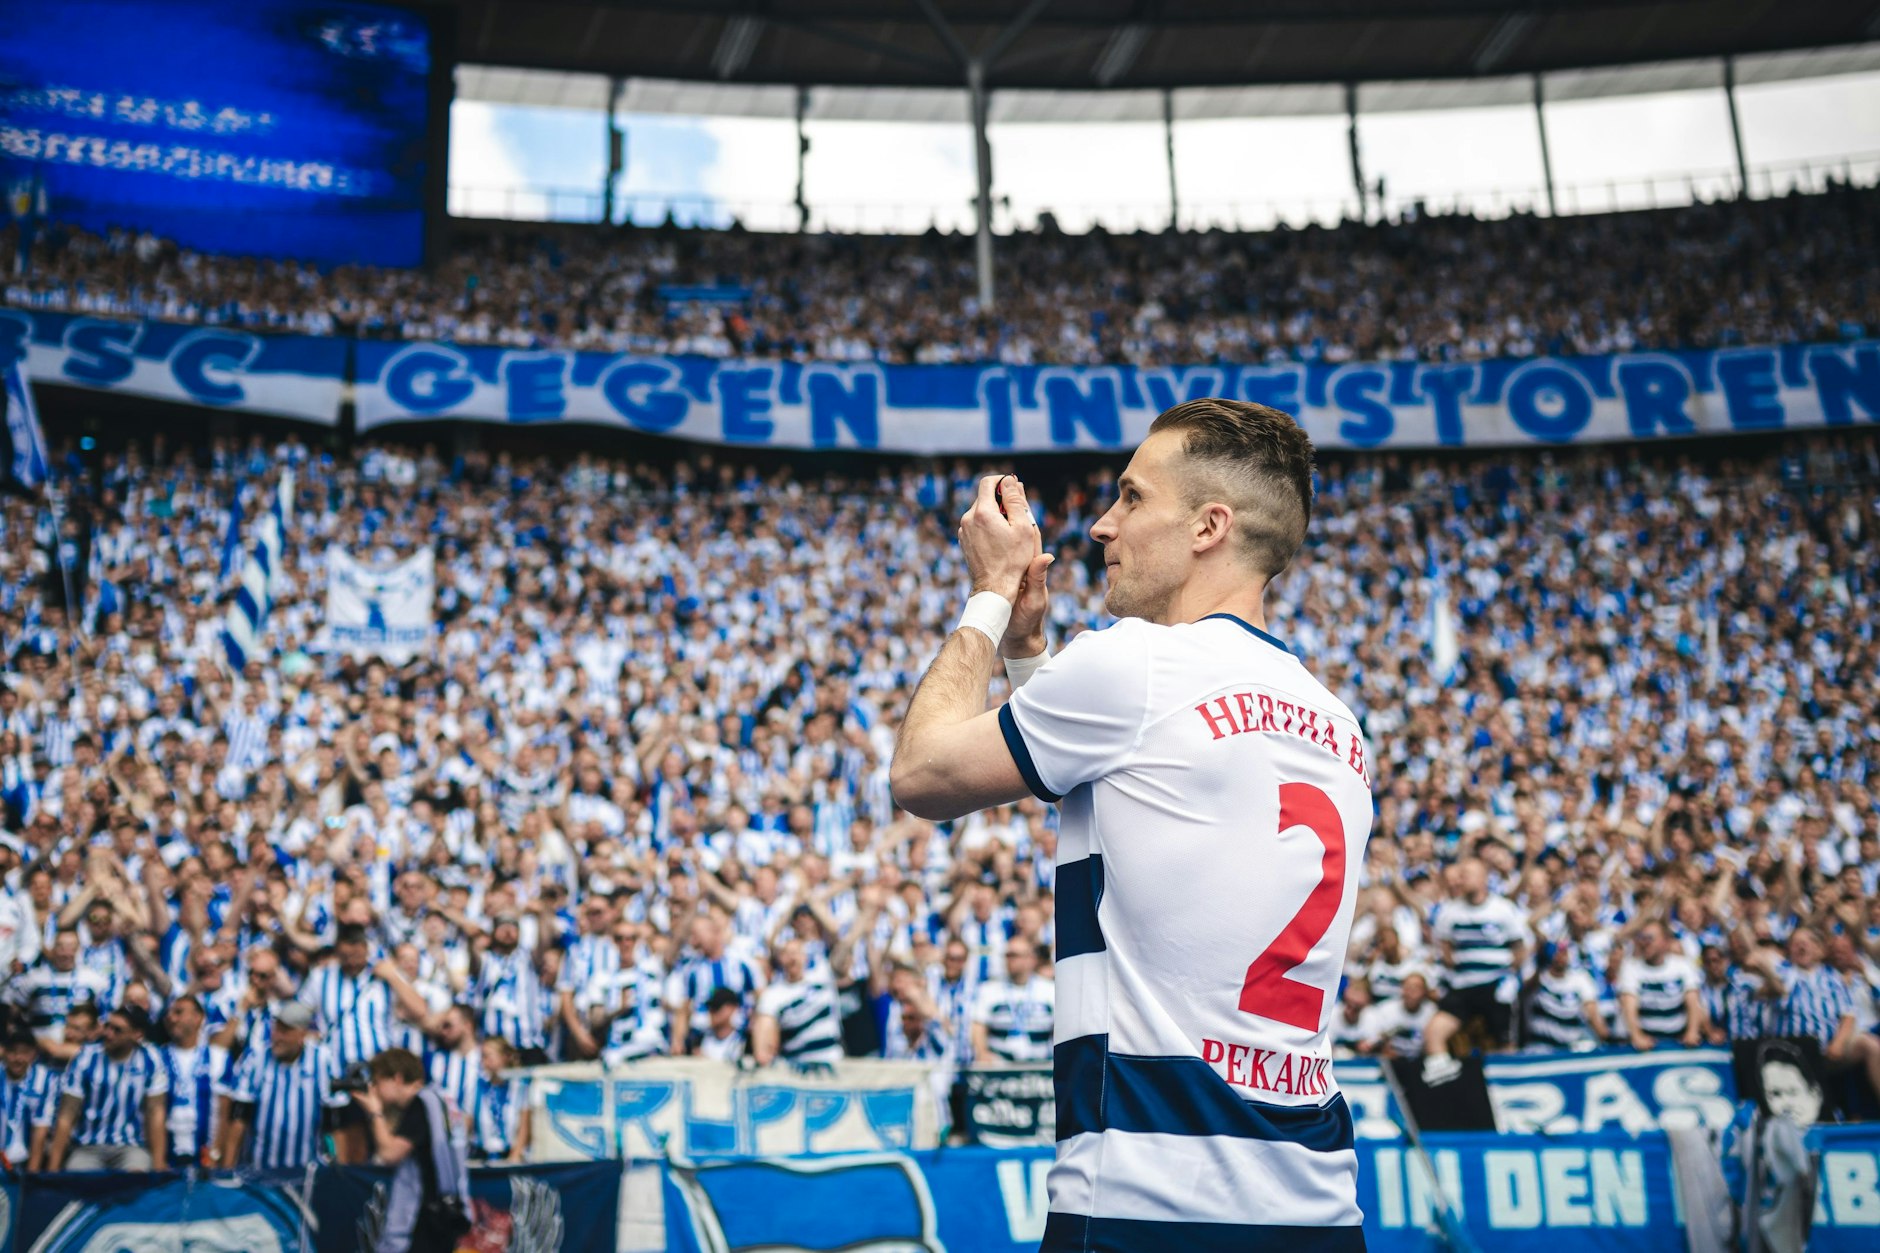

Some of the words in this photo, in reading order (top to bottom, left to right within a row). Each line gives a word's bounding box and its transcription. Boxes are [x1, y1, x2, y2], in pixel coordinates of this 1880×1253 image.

[381, 342, 884, 449] GEGEN
[1195, 692, 1341, 757] HERTHA
[1238, 782, 1346, 1032] 2
[1371, 1147, 1464, 1229] IN
[1483, 1147, 1647, 1229] DEN
